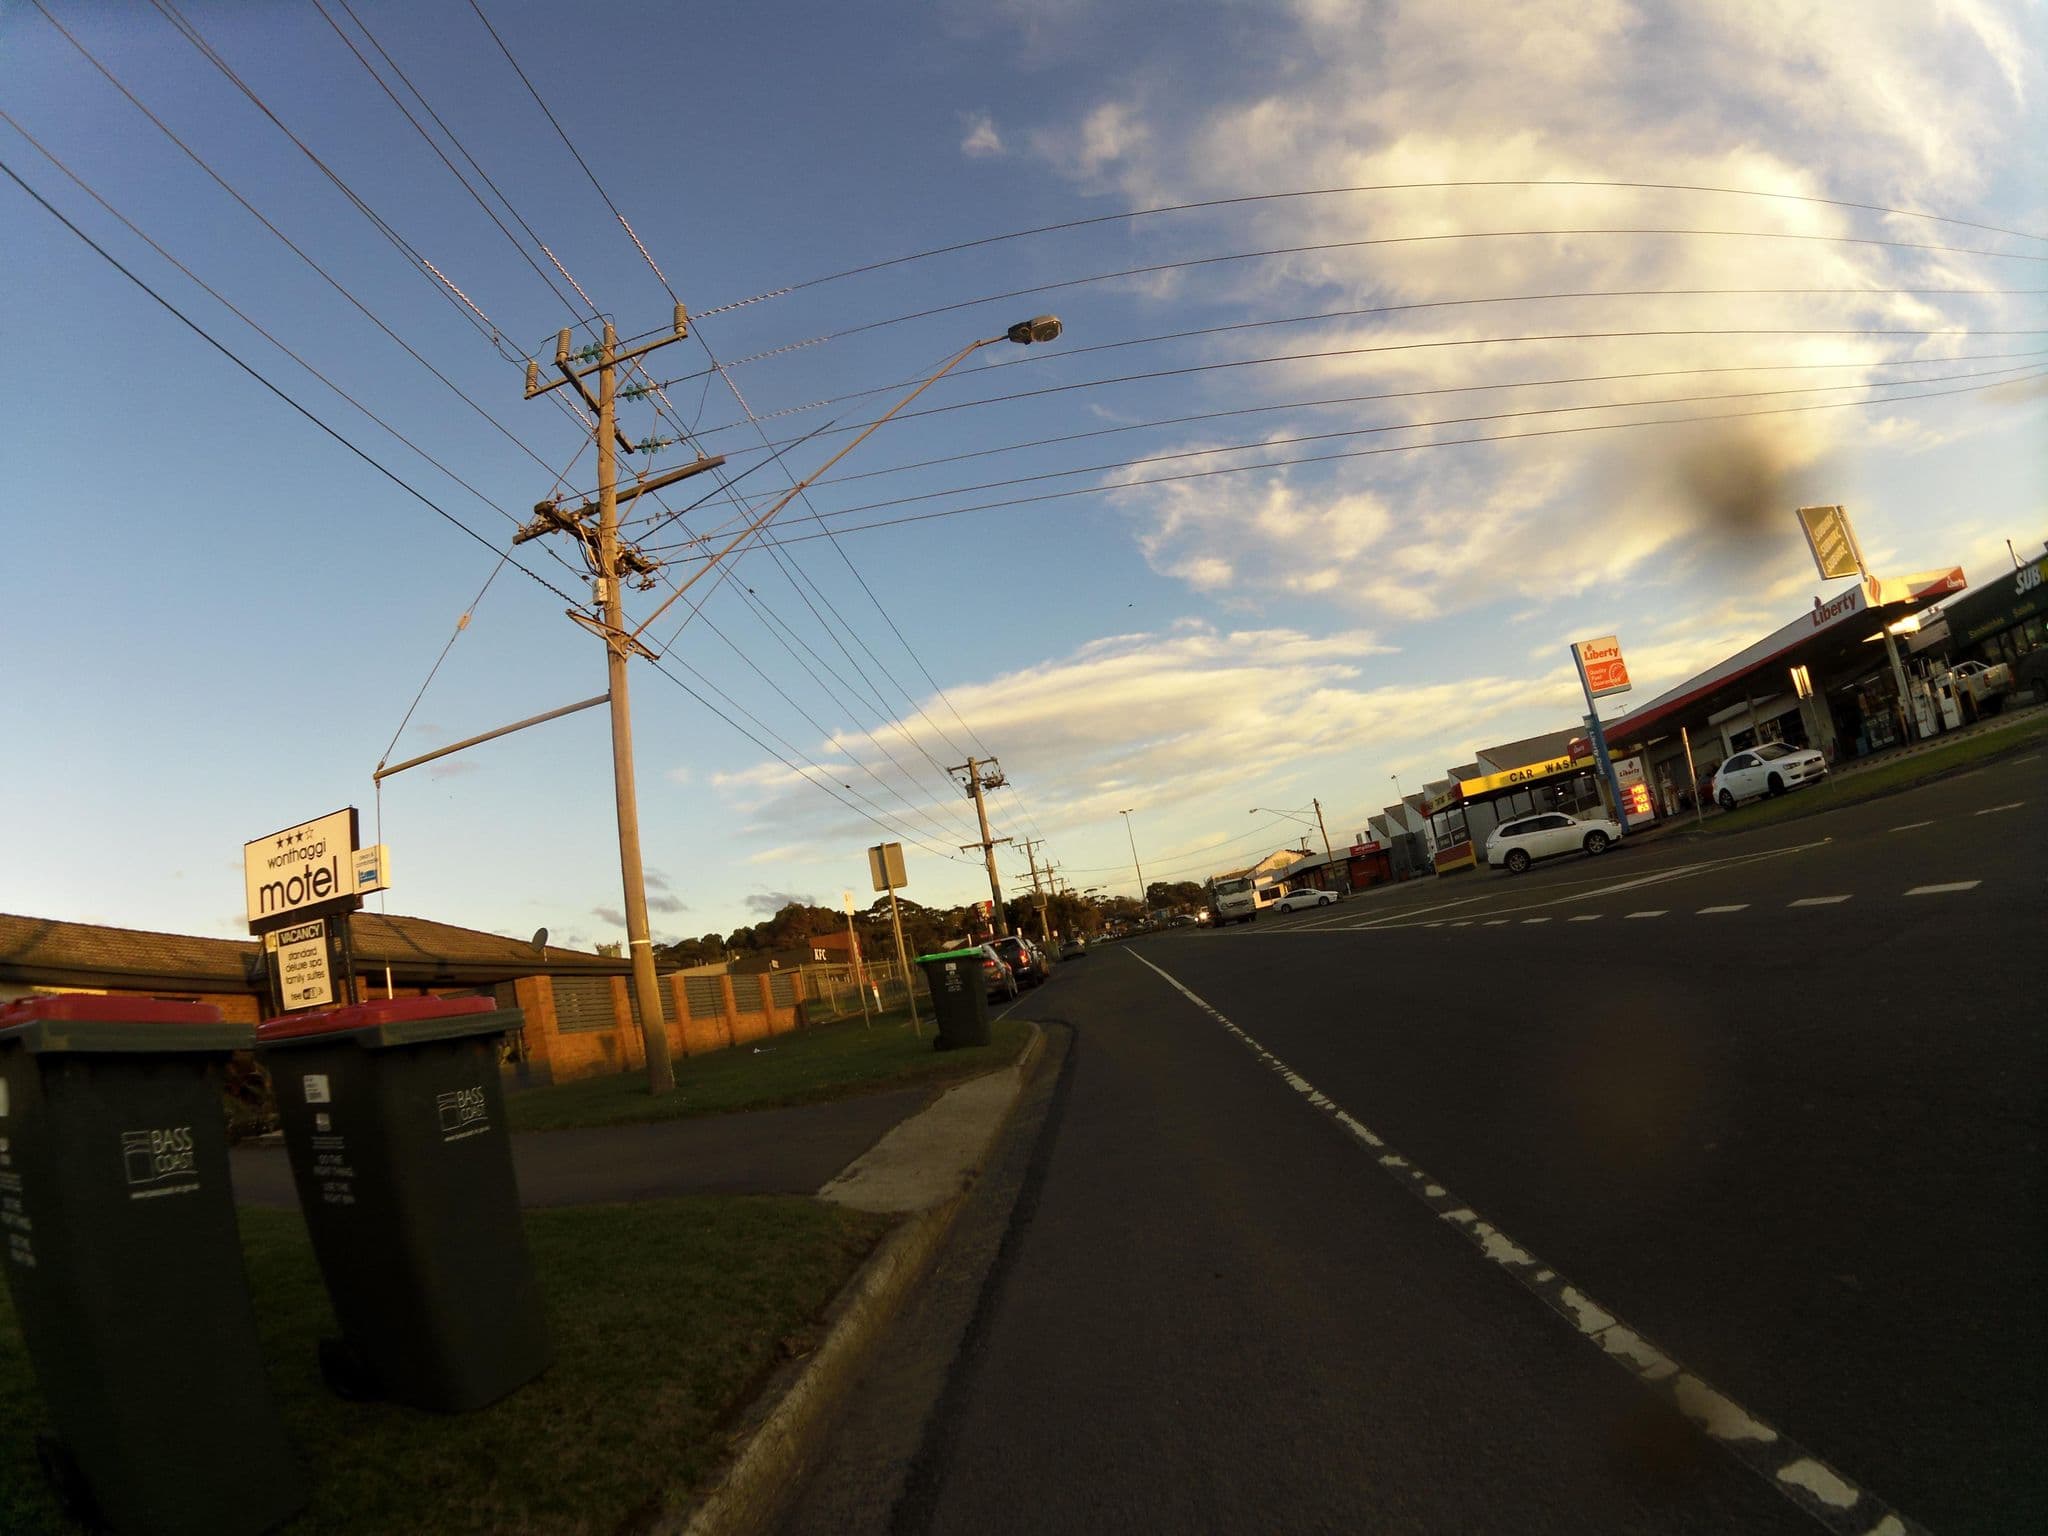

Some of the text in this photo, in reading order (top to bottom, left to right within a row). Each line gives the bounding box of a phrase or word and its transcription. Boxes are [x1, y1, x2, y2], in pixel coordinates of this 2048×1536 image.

[1811, 592, 1856, 627] Liberty
[1584, 647, 1618, 661] Liberty
[1509, 768, 1535, 783] CAR
[1544, 757, 1578, 775] WASH
[1619, 767, 1640, 778] Liberty
[267, 837, 327, 870] wonthaggi
[259, 856, 339, 914] motel
[280, 924, 320, 945] VACANCY
[288, 947, 317, 961] standard
[814, 948, 827, 961] KFC
[286, 958, 323, 972] deluxe spa
[286, 970, 326, 985] family suites
[456, 1086, 485, 1108] BASS
[460, 1103, 486, 1121] COAST
[151, 1127, 194, 1155] BASS
[155, 1151, 194, 1172] COAST
